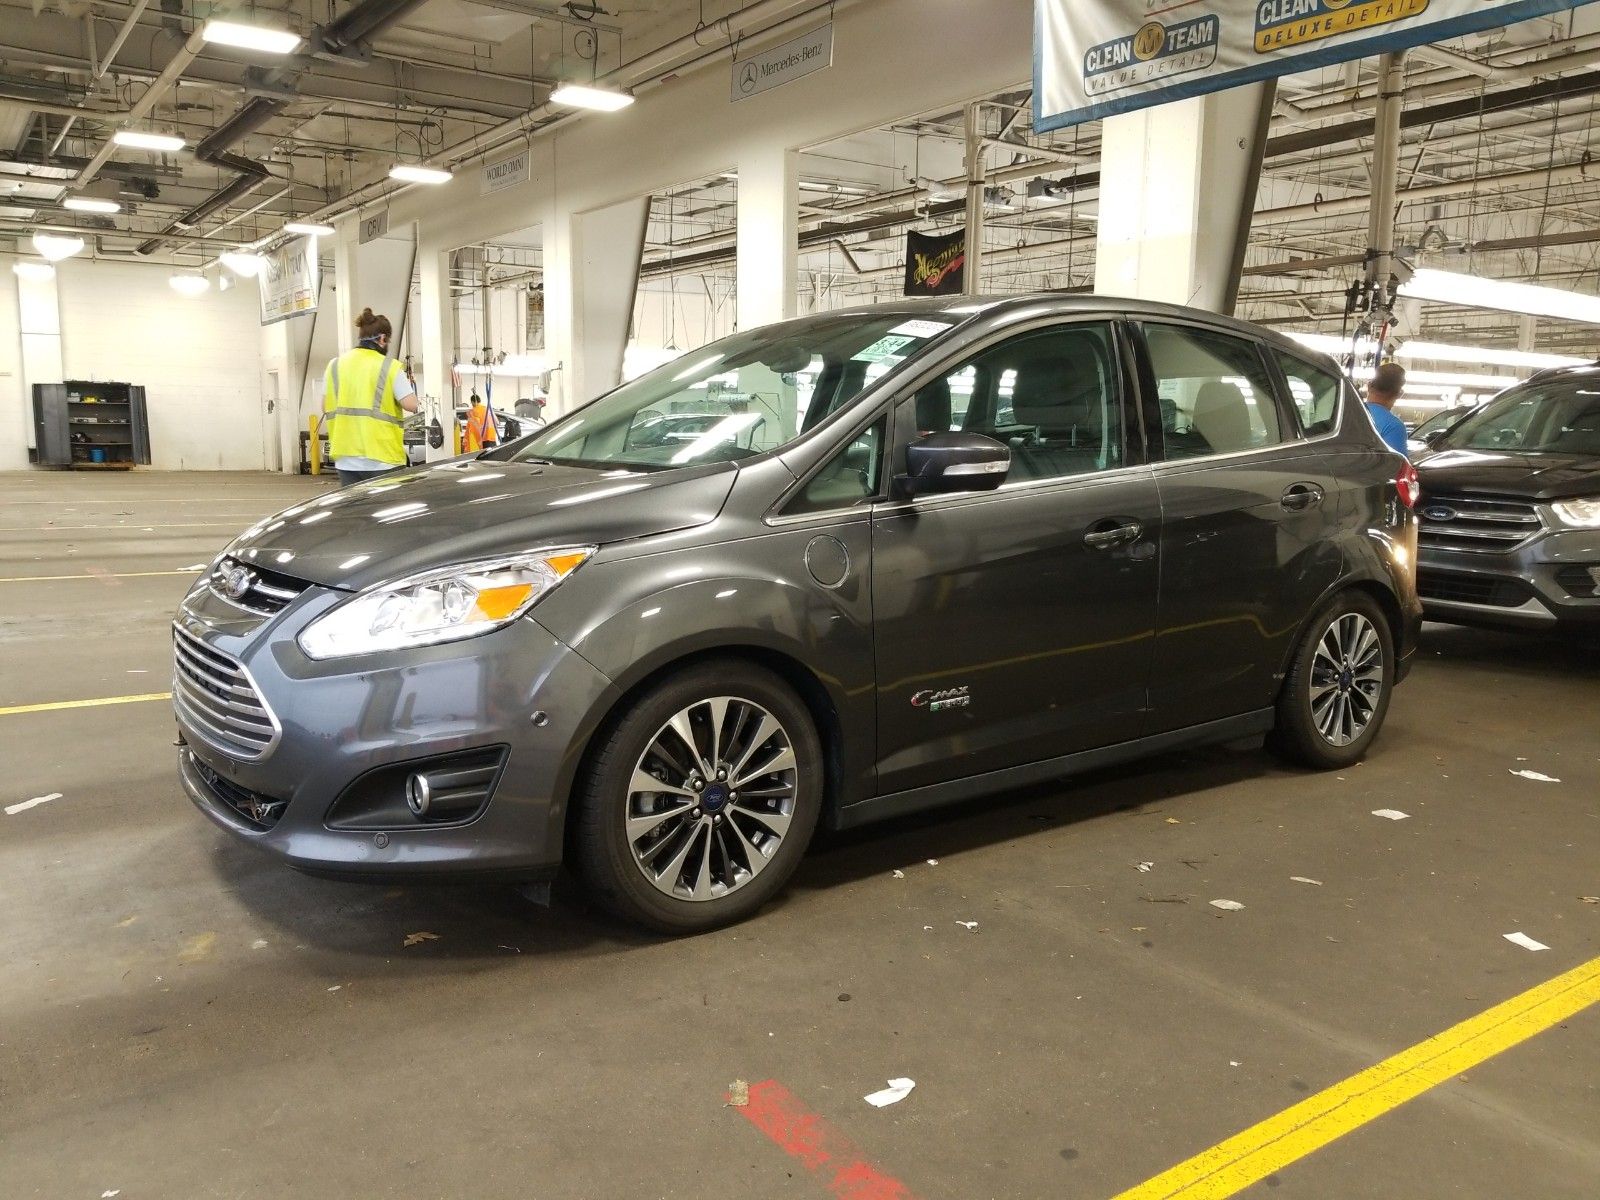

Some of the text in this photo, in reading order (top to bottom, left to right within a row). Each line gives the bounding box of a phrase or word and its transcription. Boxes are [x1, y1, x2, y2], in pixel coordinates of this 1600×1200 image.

[1260, 0, 1318, 25] CLEAN
[1263, 0, 1415, 46] DELUXE DETAIL
[760, 43, 822, 78] Mercedes-Benz
[1086, 41, 1131, 72] CLEAN
[1167, 20, 1214, 52] TEAM
[1091, 52, 1205, 90] VALUE DETAIL
[487, 163, 507, 180] WORLD
